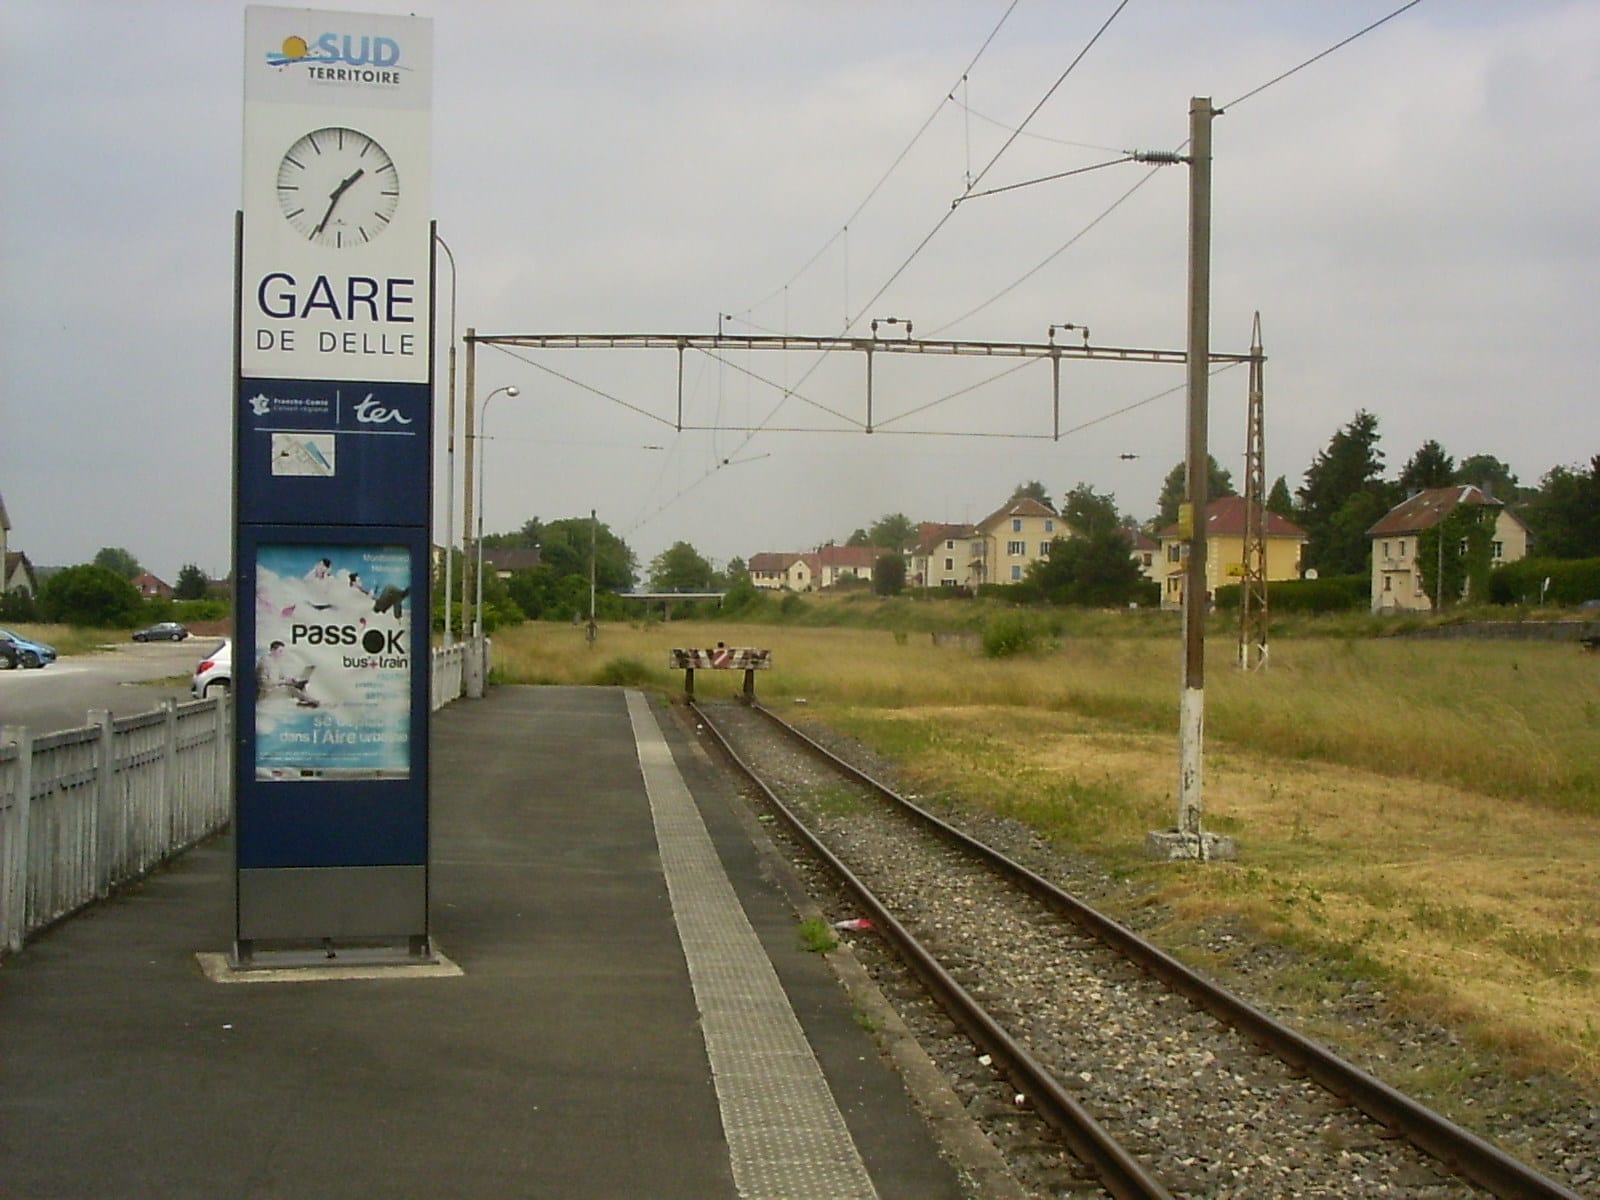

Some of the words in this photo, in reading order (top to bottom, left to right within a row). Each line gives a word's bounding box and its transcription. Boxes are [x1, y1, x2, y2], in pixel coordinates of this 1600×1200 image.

[315, 32, 400, 67] SUD
[308, 67, 401, 84] TERRITOIRE
[257, 273, 415, 323] GARE
[256, 329, 295, 351] DE
[319, 331, 414, 356] DELLE
[353, 393, 412, 424] ter
